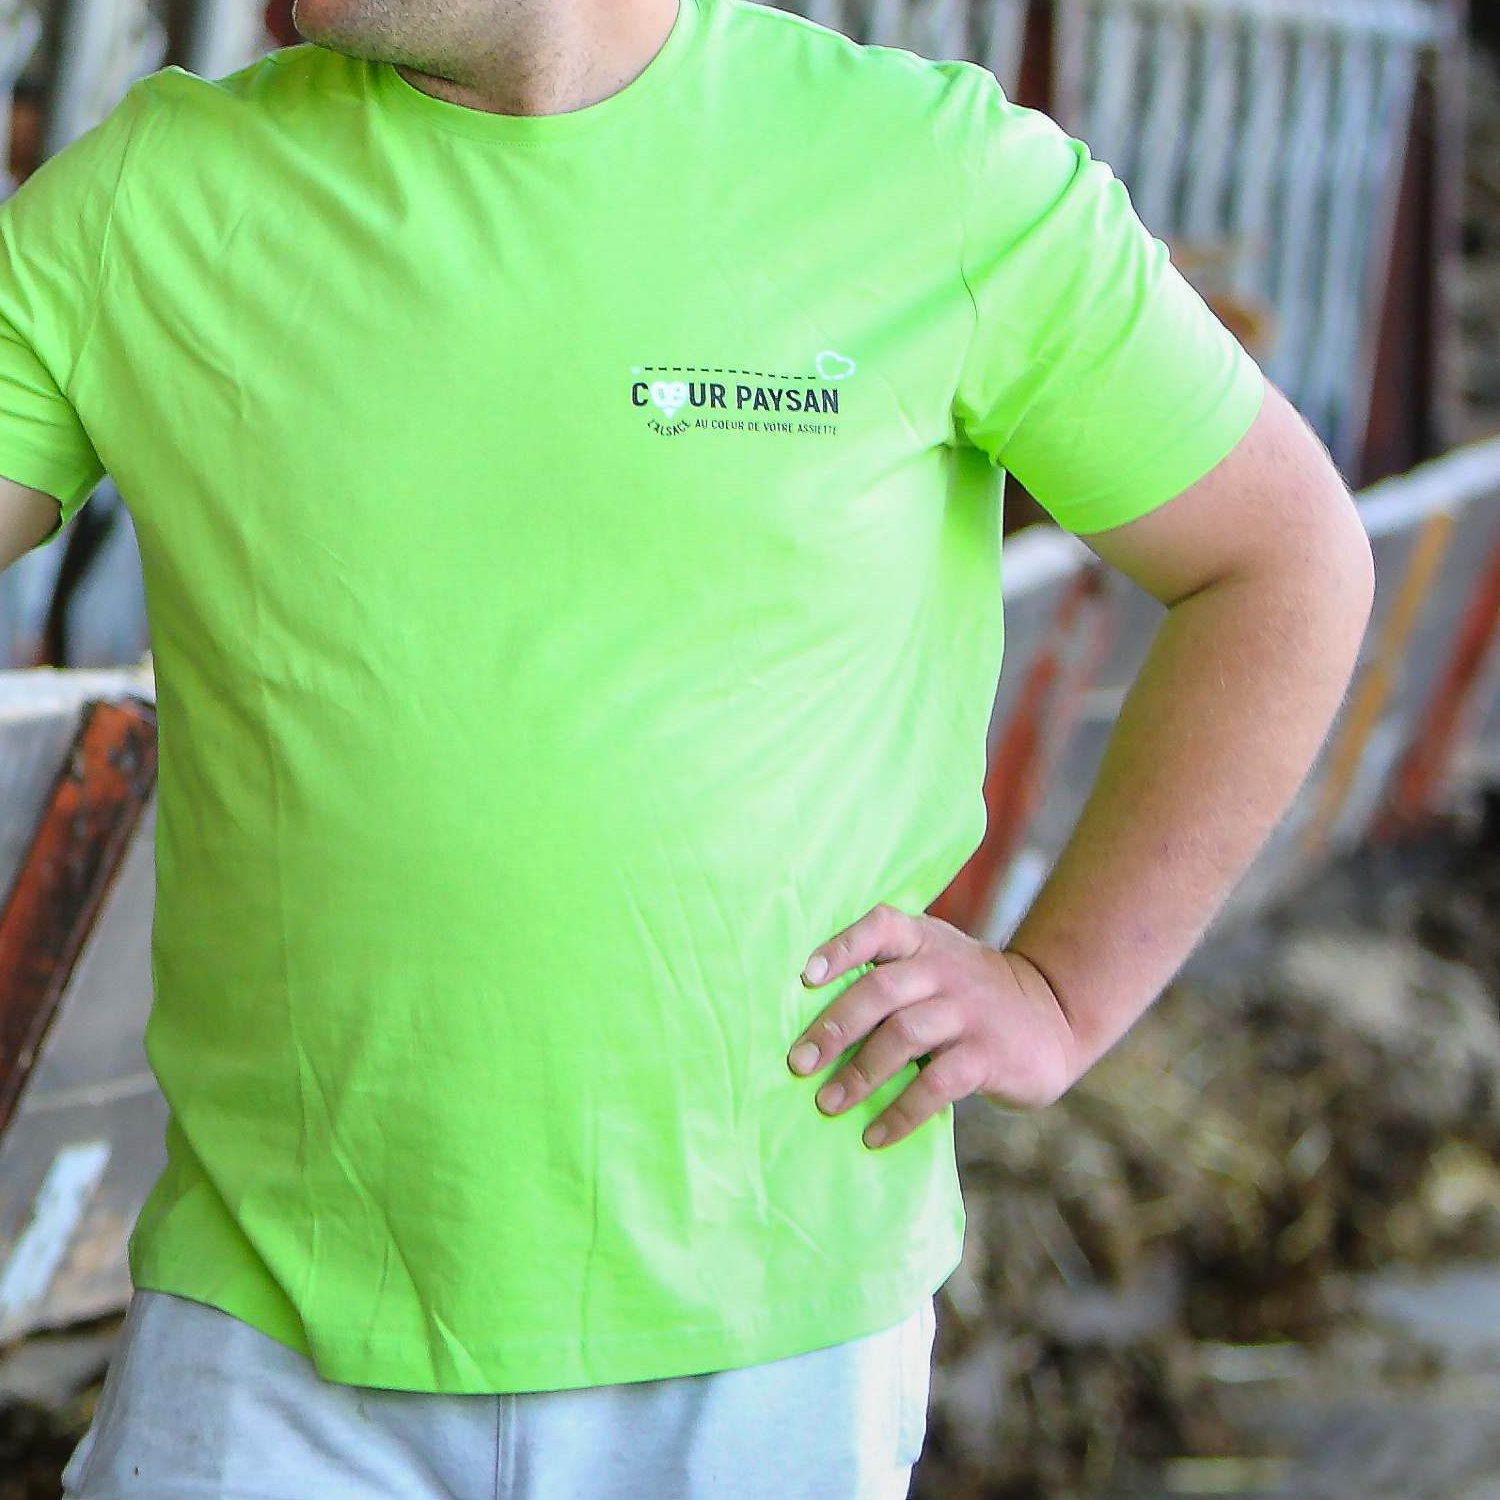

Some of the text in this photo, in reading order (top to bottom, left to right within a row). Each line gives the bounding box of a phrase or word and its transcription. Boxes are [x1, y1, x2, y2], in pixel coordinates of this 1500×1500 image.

[737, 385, 838, 414] PAYSAN
[694, 418, 708, 430] AU
[711, 420, 745, 431] COEUR
[747, 422, 760, 432] DE
[763, 422, 794, 434] VOTRE
